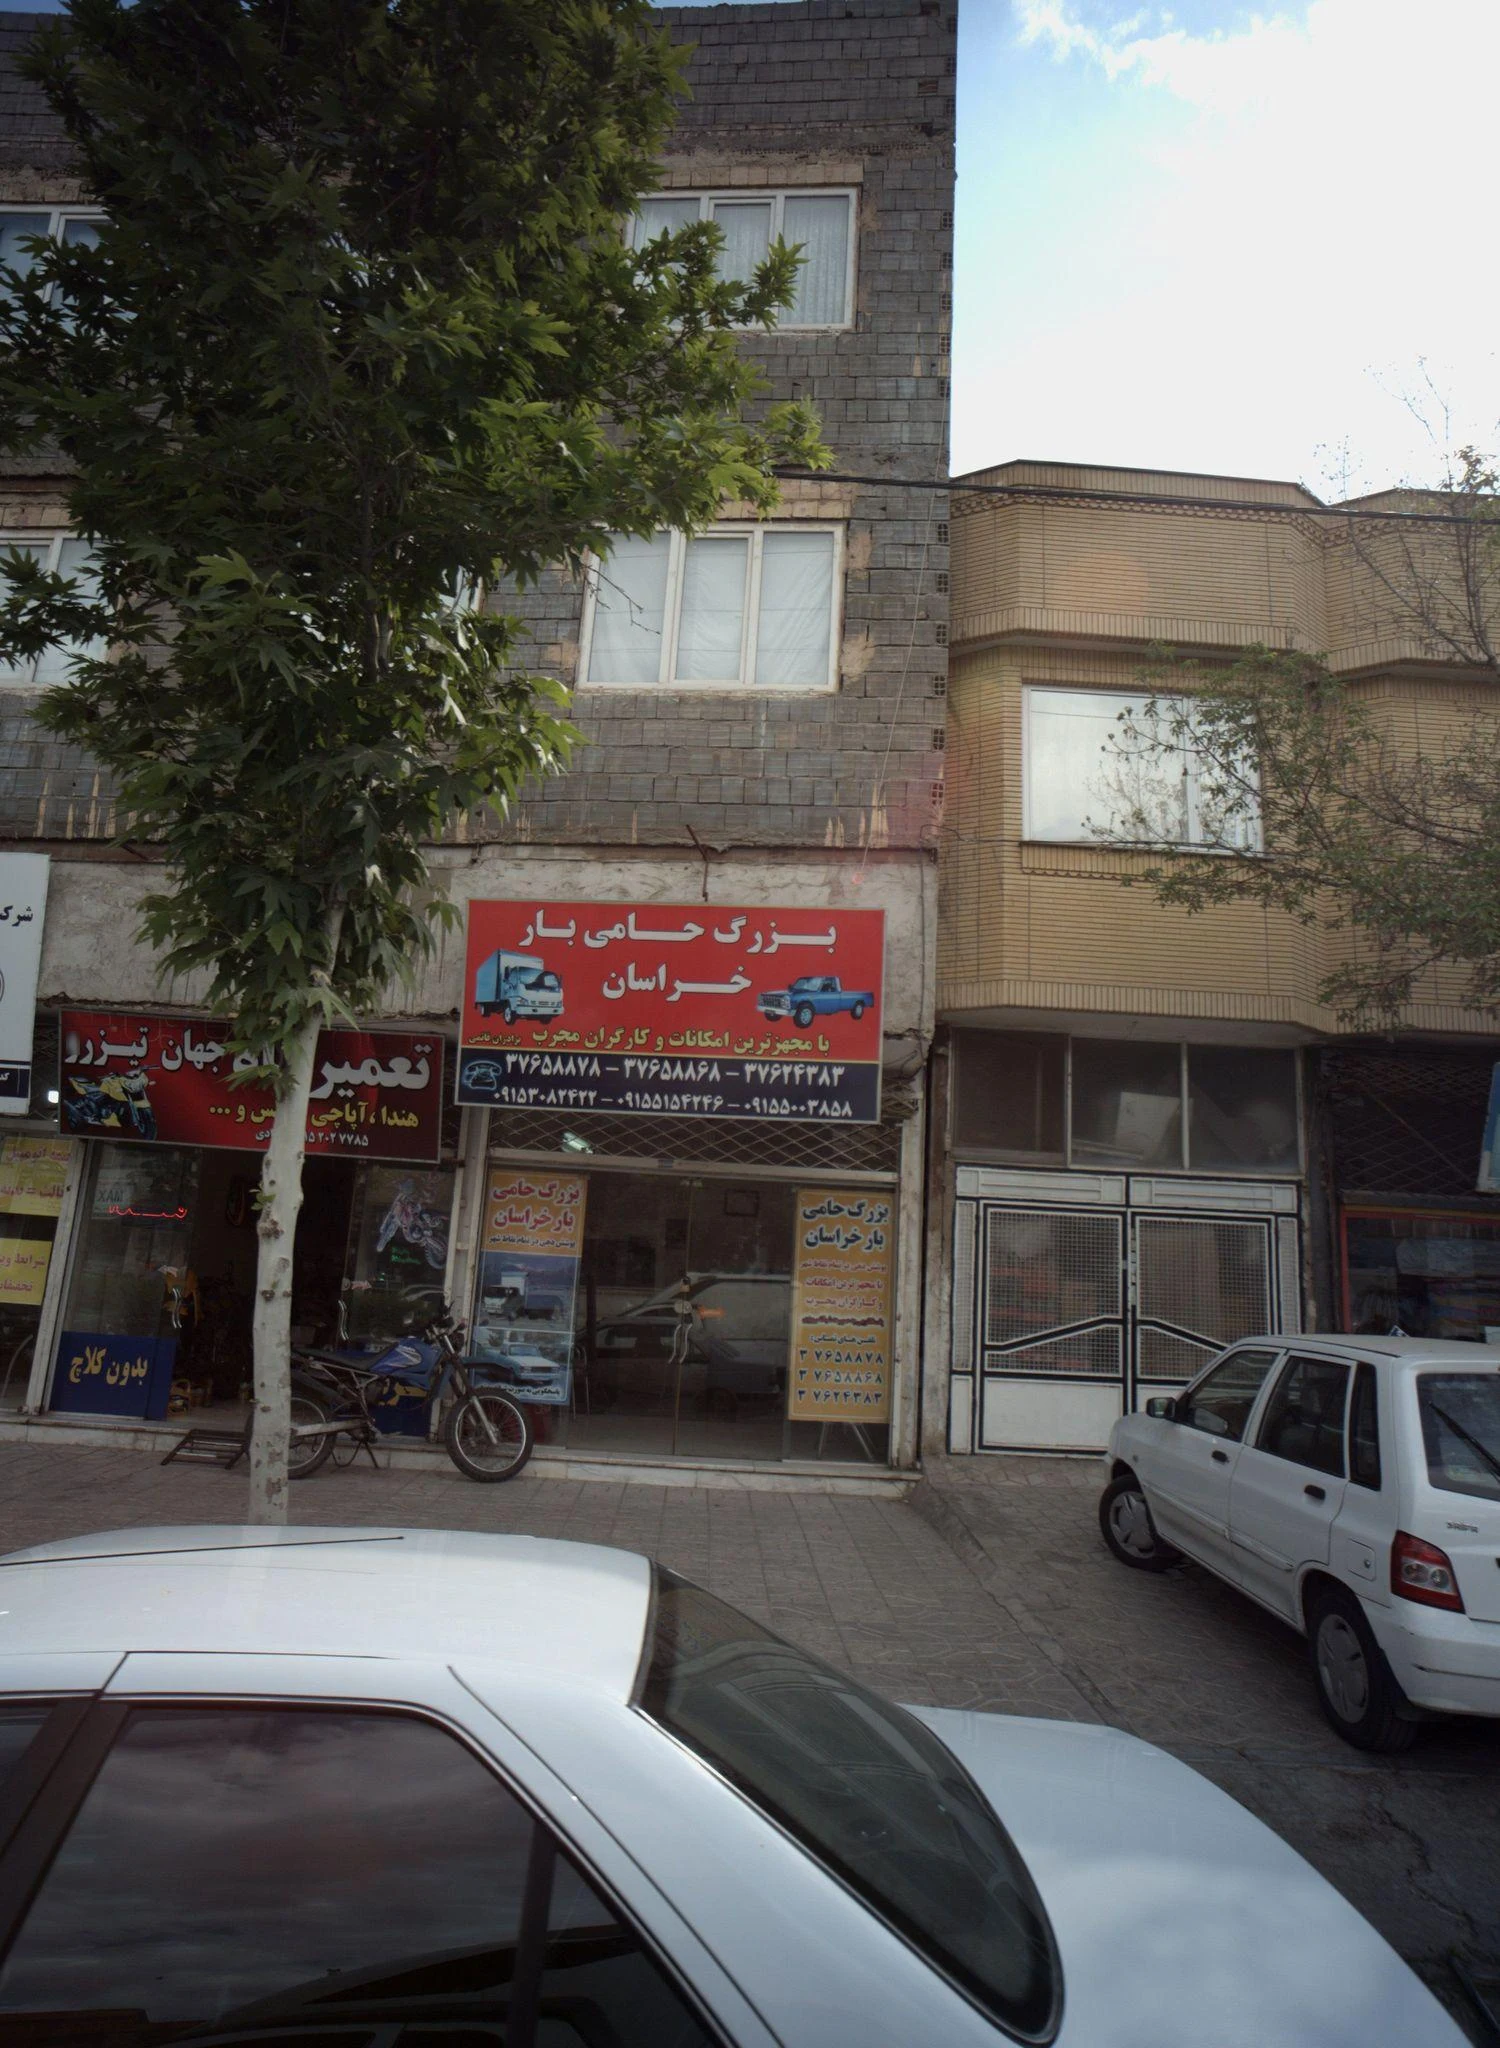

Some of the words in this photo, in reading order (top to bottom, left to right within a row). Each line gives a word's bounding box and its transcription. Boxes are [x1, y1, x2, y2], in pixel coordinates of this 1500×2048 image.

[517, 908, 577, 947] بار
[583, 911, 705, 949] حامی
[713, 915, 837, 954] بزرگ
[602, 961, 753, 1002] خراسان
[532, 1028, 581, 1047] مجرب
[584, 1027, 651, 1050] کارگران
[655, 1035, 664, 1051] و
[668, 1029, 730, 1048] امکانات
[818, 1034, 830, 1056] با
[161, 1028, 227, 1072] جهان
[505, 1053, 601, 1077] ۳۷۶۵۸۸۷۸
[624, 1058, 721, 1082] ۳۷۶۵۸۸۶۸
[744, 1063, 845, 1087] ۳۷۶۲۴۳۸۳
[618, 1091, 724, 1112] ۰۹۱۵۵۱۵۴۲۴۶
[744, 1097, 853, 1117] ۰۹۱۵۵۰۰۳۸۵۸
[311, 1101, 369, 1130] آپاچی
[493, 1180, 535, 1199] حامی
[538, 1182, 580, 1204] بزرگ
[494, 1207, 552, 1229] خراسان
[803, 1199, 845, 1219] حامی
[848, 1202, 889, 1223] بزرگ
[552, 1210, 574, 1231] بار
[805, 1227, 862, 1248] خراسان
[865, 1230, 884, 1250] بار
[106, 1356, 148, 1386] بدون
